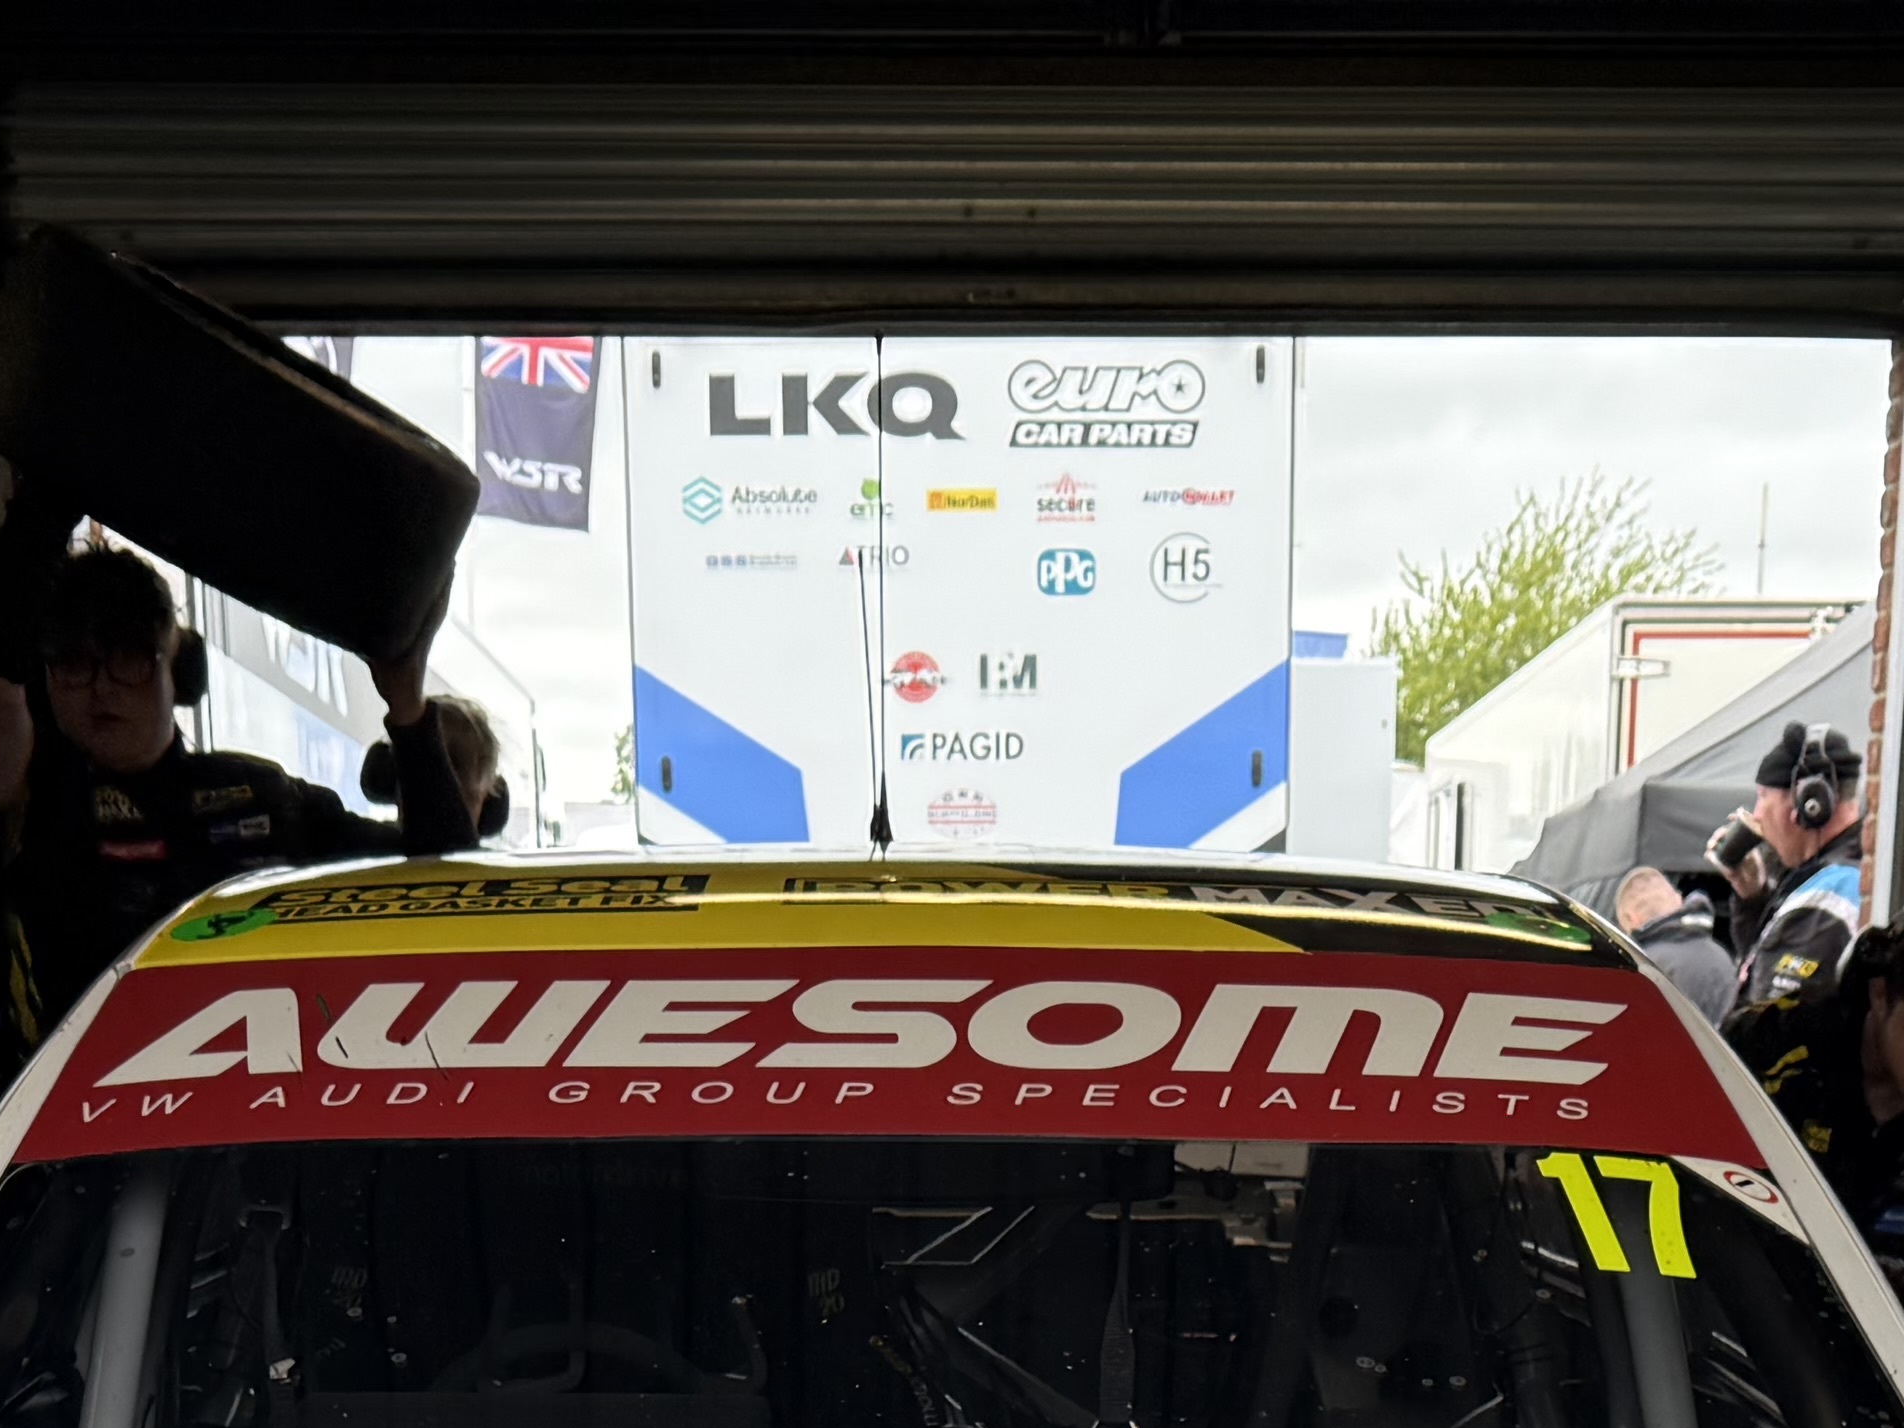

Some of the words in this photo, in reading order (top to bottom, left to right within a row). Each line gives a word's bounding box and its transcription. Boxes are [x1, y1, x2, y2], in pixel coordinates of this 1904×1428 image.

[709, 372, 966, 441] LKQ
[1018, 422, 1083, 446] CAR
[1087, 422, 1195, 446] PARTS
[483, 451, 583, 494] WSR
[1162, 545, 1211, 583] H5
[932, 731, 1024, 761] PAGID
[277, 881, 486, 905] Steel
[509, 876, 688, 897] Seal
[401, 896, 587, 916] GASKET
[93, 975, 1628, 1088] AWESOME
[81, 1090, 192, 1124] VW
[250, 1079, 476, 1107] AUDI
[549, 1077, 878, 1108] GROUP
[945, 1081, 1590, 1122] SPECIALISTS
[1536, 1152, 1697, 1279] 17
